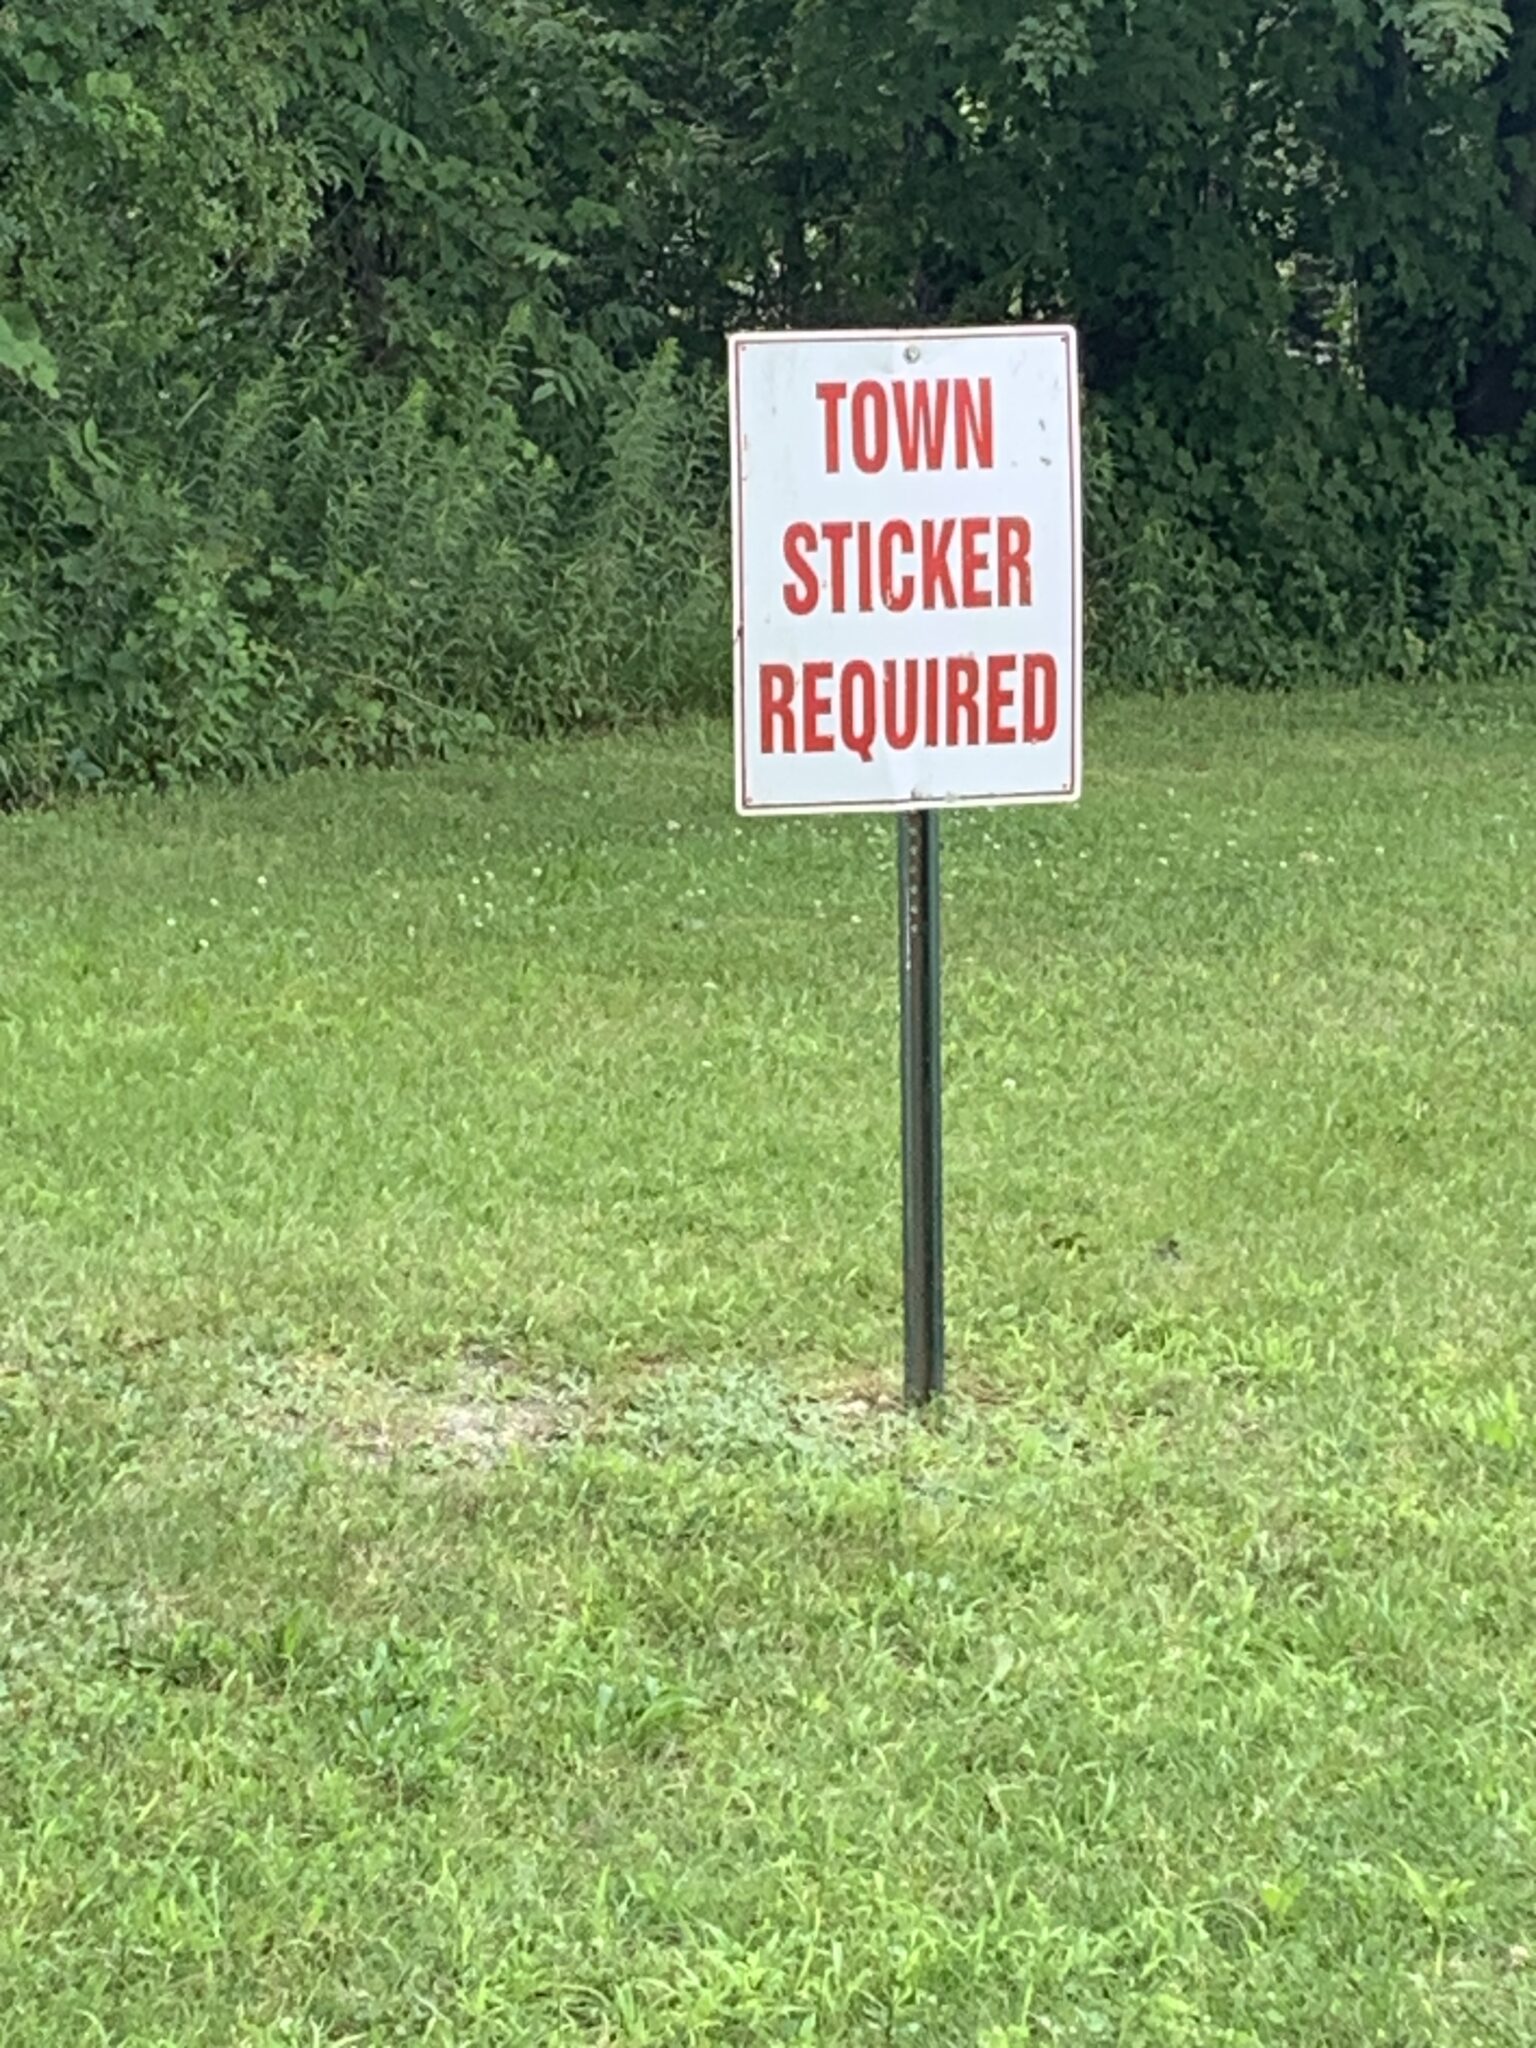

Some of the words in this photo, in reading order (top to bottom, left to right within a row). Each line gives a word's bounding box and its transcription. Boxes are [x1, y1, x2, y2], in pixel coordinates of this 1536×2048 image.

[816, 378, 993, 474] TOWN
[782, 516, 1031, 615] STICKER
[759, 652, 1057, 762] REQUIRED
